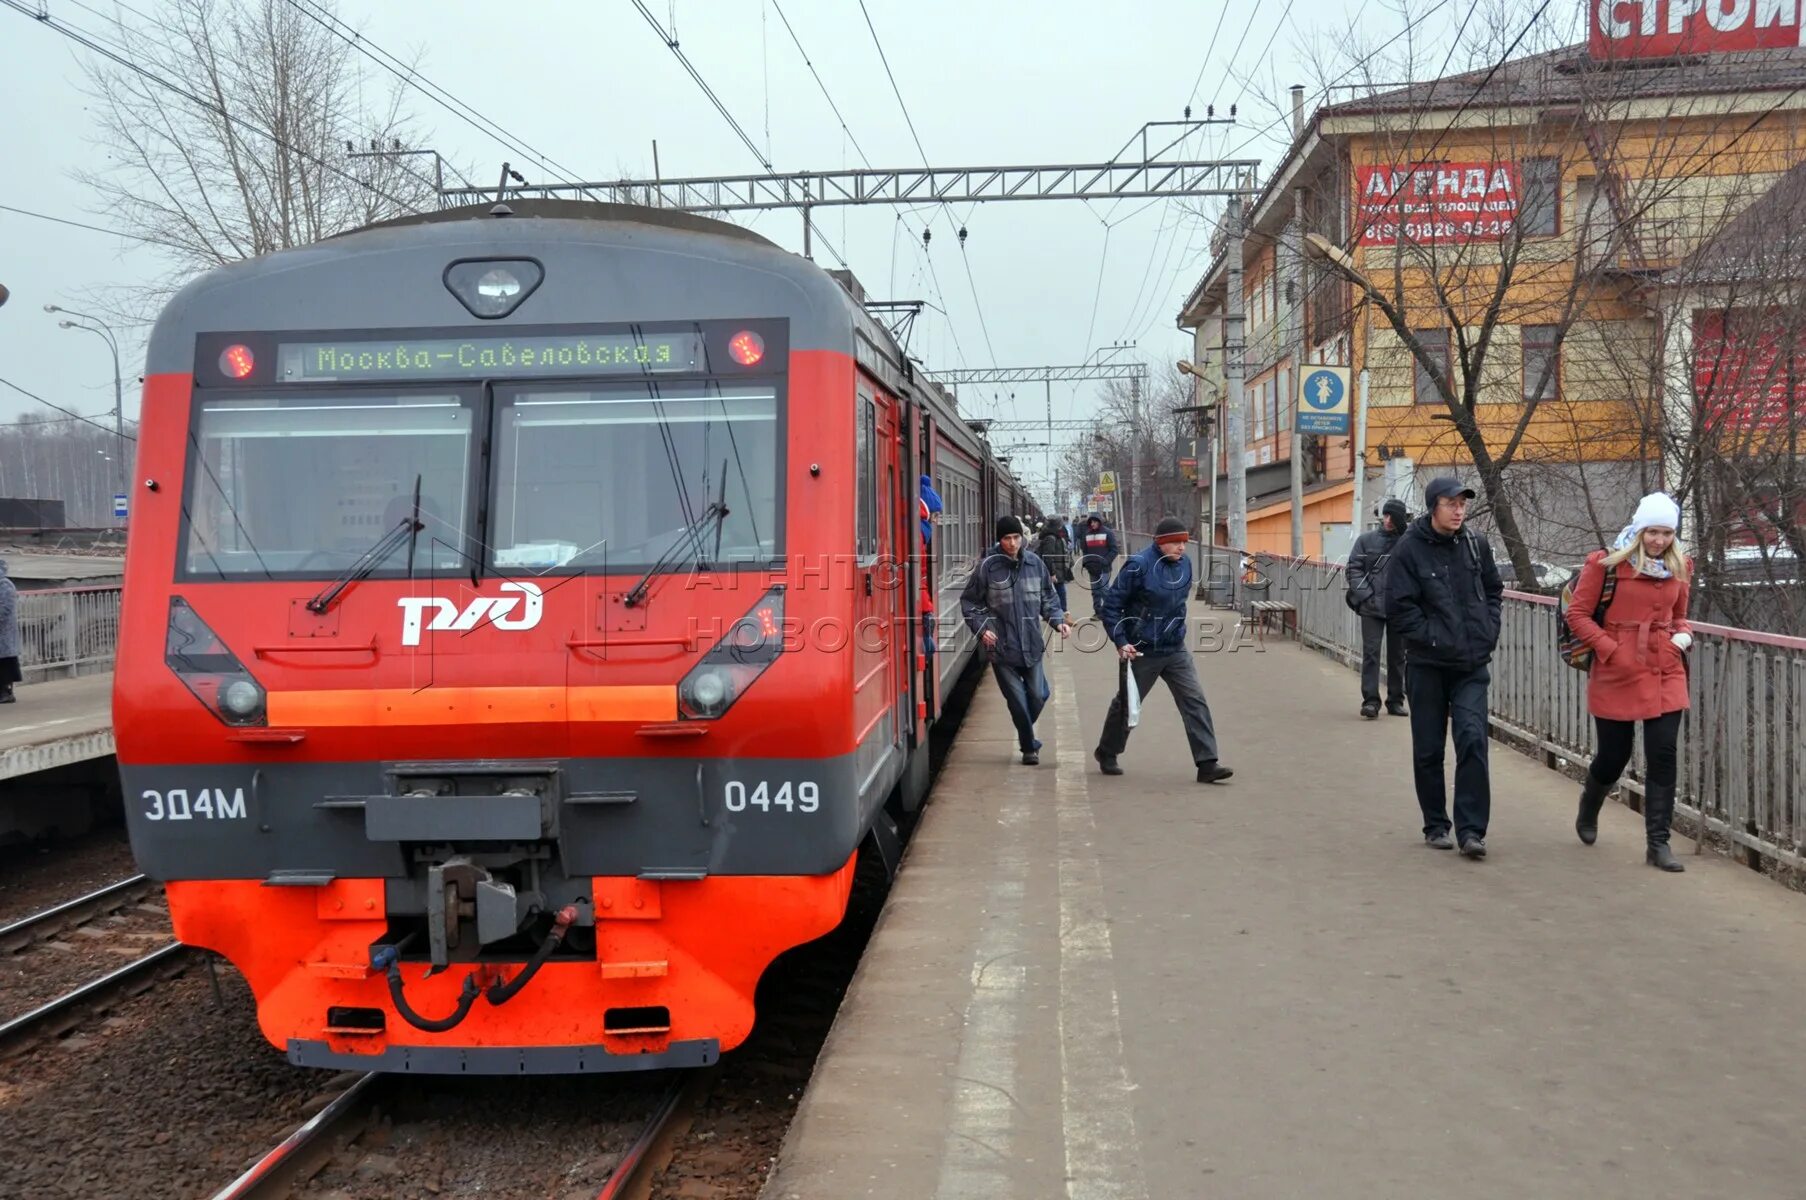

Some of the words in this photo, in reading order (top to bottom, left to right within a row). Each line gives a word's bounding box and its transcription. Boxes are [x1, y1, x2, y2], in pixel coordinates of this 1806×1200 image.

[1365, 168, 1512, 198] АРЕНДА
[142, 788, 247, 820] ЭД4М
[724, 781, 819, 812] 0449
